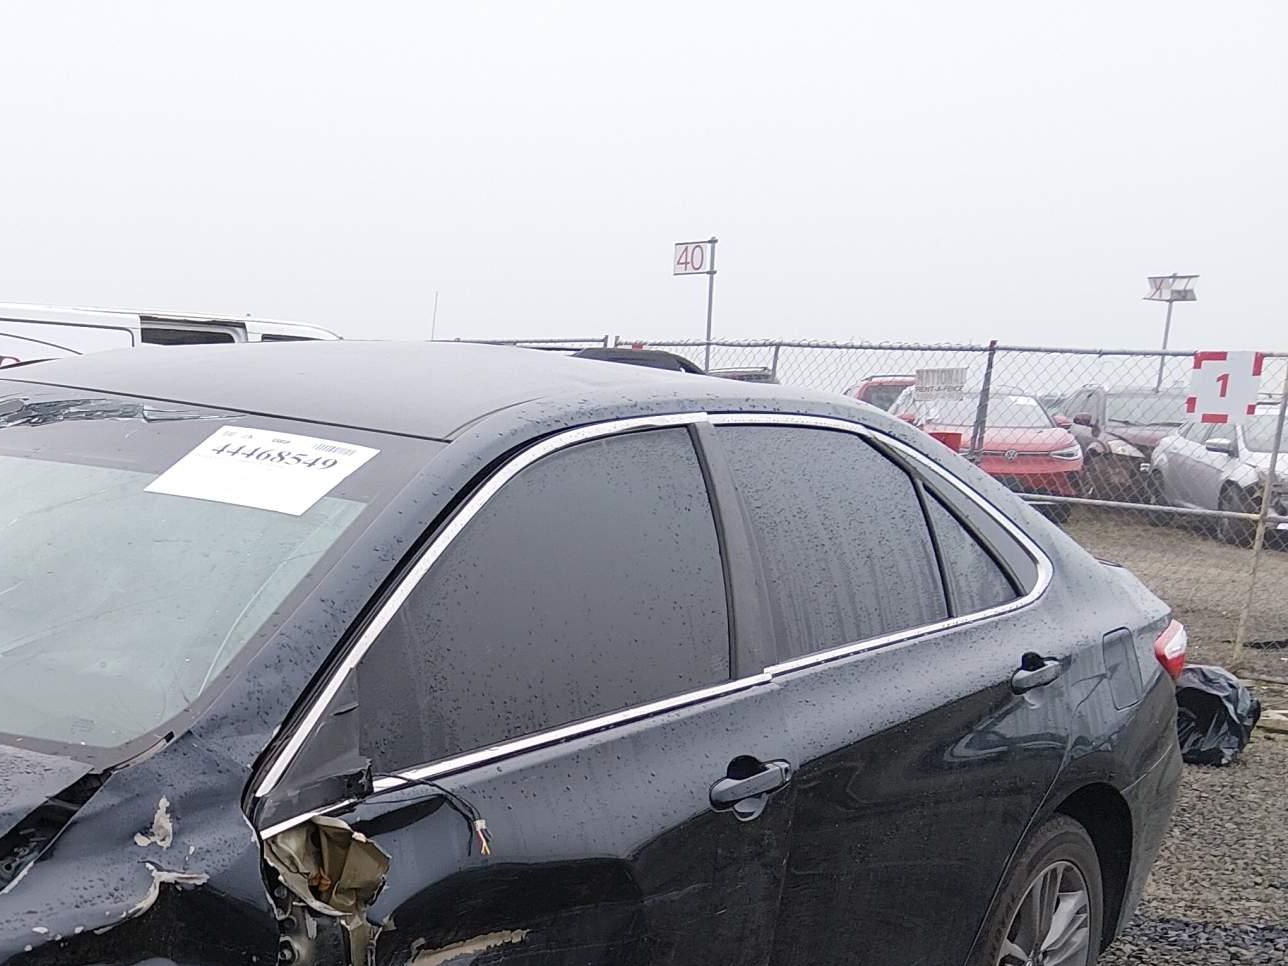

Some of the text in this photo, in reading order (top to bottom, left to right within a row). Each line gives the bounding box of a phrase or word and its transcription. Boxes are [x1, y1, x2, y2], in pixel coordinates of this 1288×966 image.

[677, 244, 704, 271] 40
[1216, 373, 1230, 398] 1
[212, 443, 338, 470] 44468549
